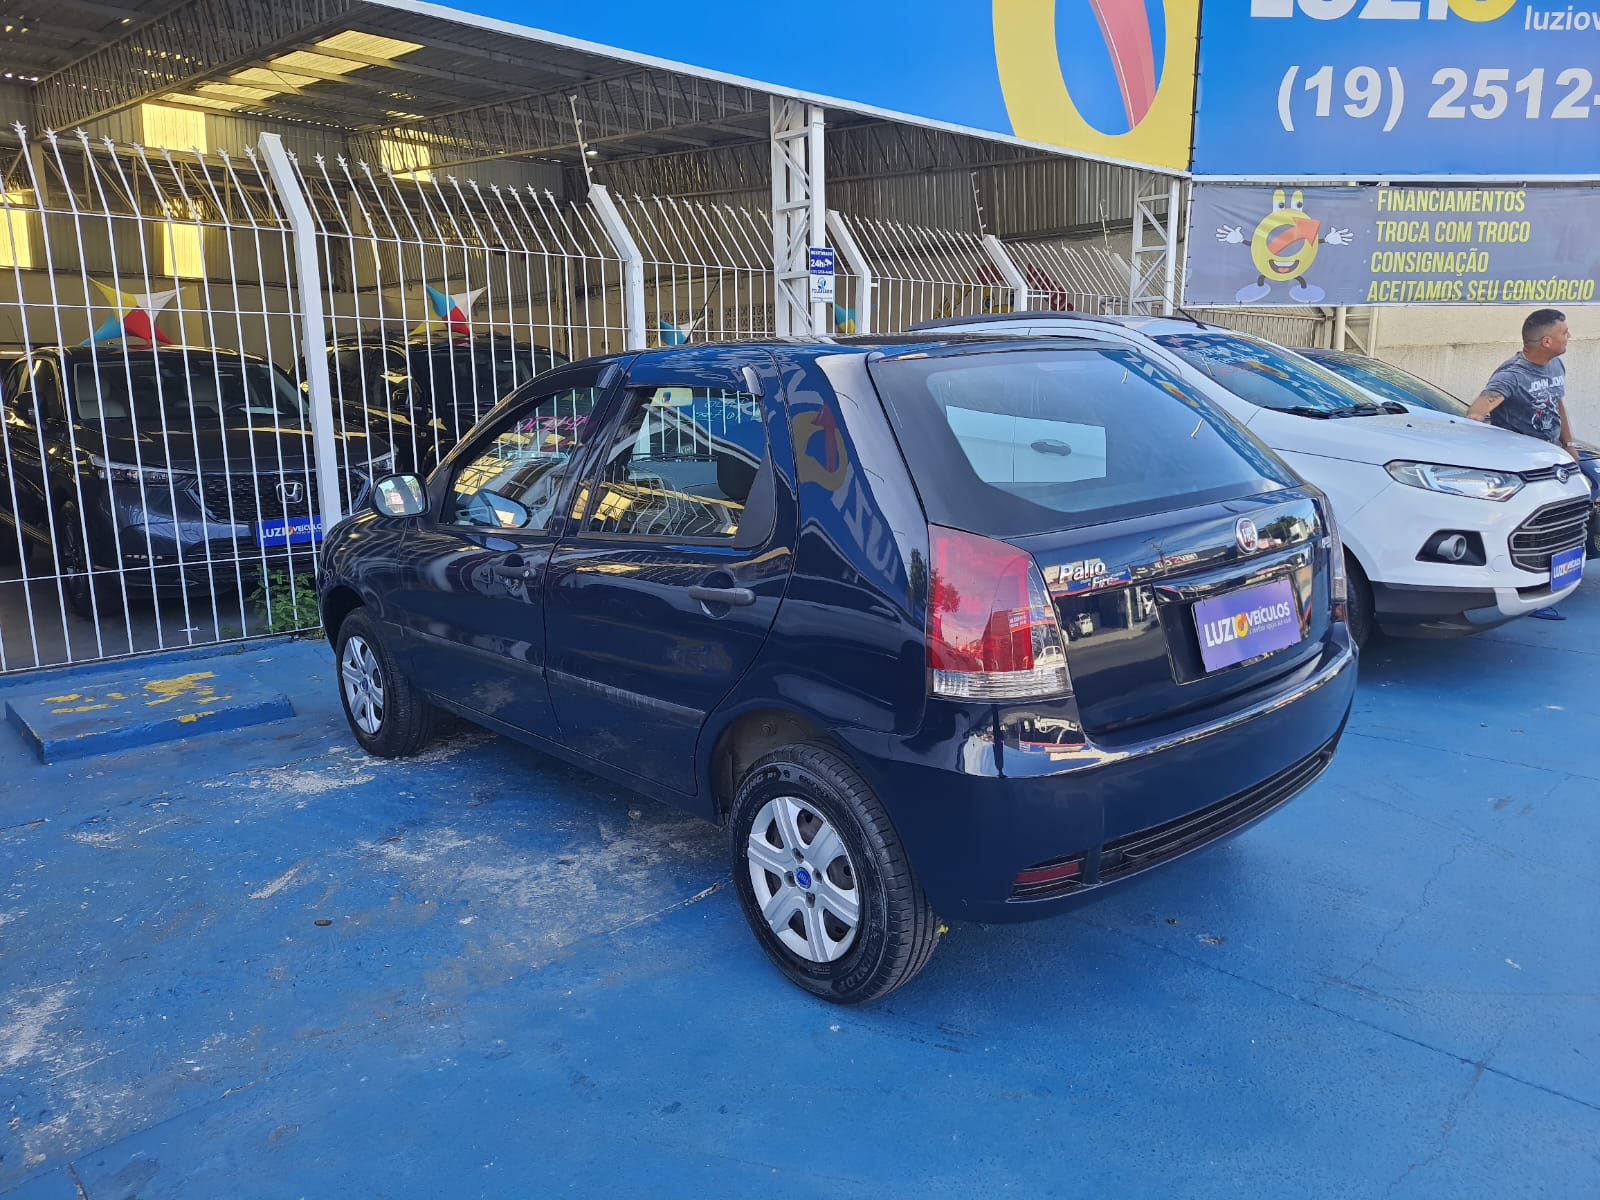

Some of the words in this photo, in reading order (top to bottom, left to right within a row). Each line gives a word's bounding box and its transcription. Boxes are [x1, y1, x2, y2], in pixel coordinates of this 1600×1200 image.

[1277, 65, 1405, 132] (19)
[1376, 190, 1526, 213] FINANCIAMENTOS
[1375, 220, 1430, 243] TROCA
[1434, 220, 1472, 243] COM
[1477, 221, 1531, 243] TROCO
[1370, 248, 1489, 277] CONSIGNAÇÃO
[1366, 280, 1464, 302] ACEITAMOS
[1467, 279, 1499, 301] SEU
[1502, 275, 1595, 301] CONSÓRCIO
[1058, 559, 1107, 584] Palio
[1204, 612, 1249, 648] LUZIO
[1245, 601, 1291, 627] VEÍCULOS
